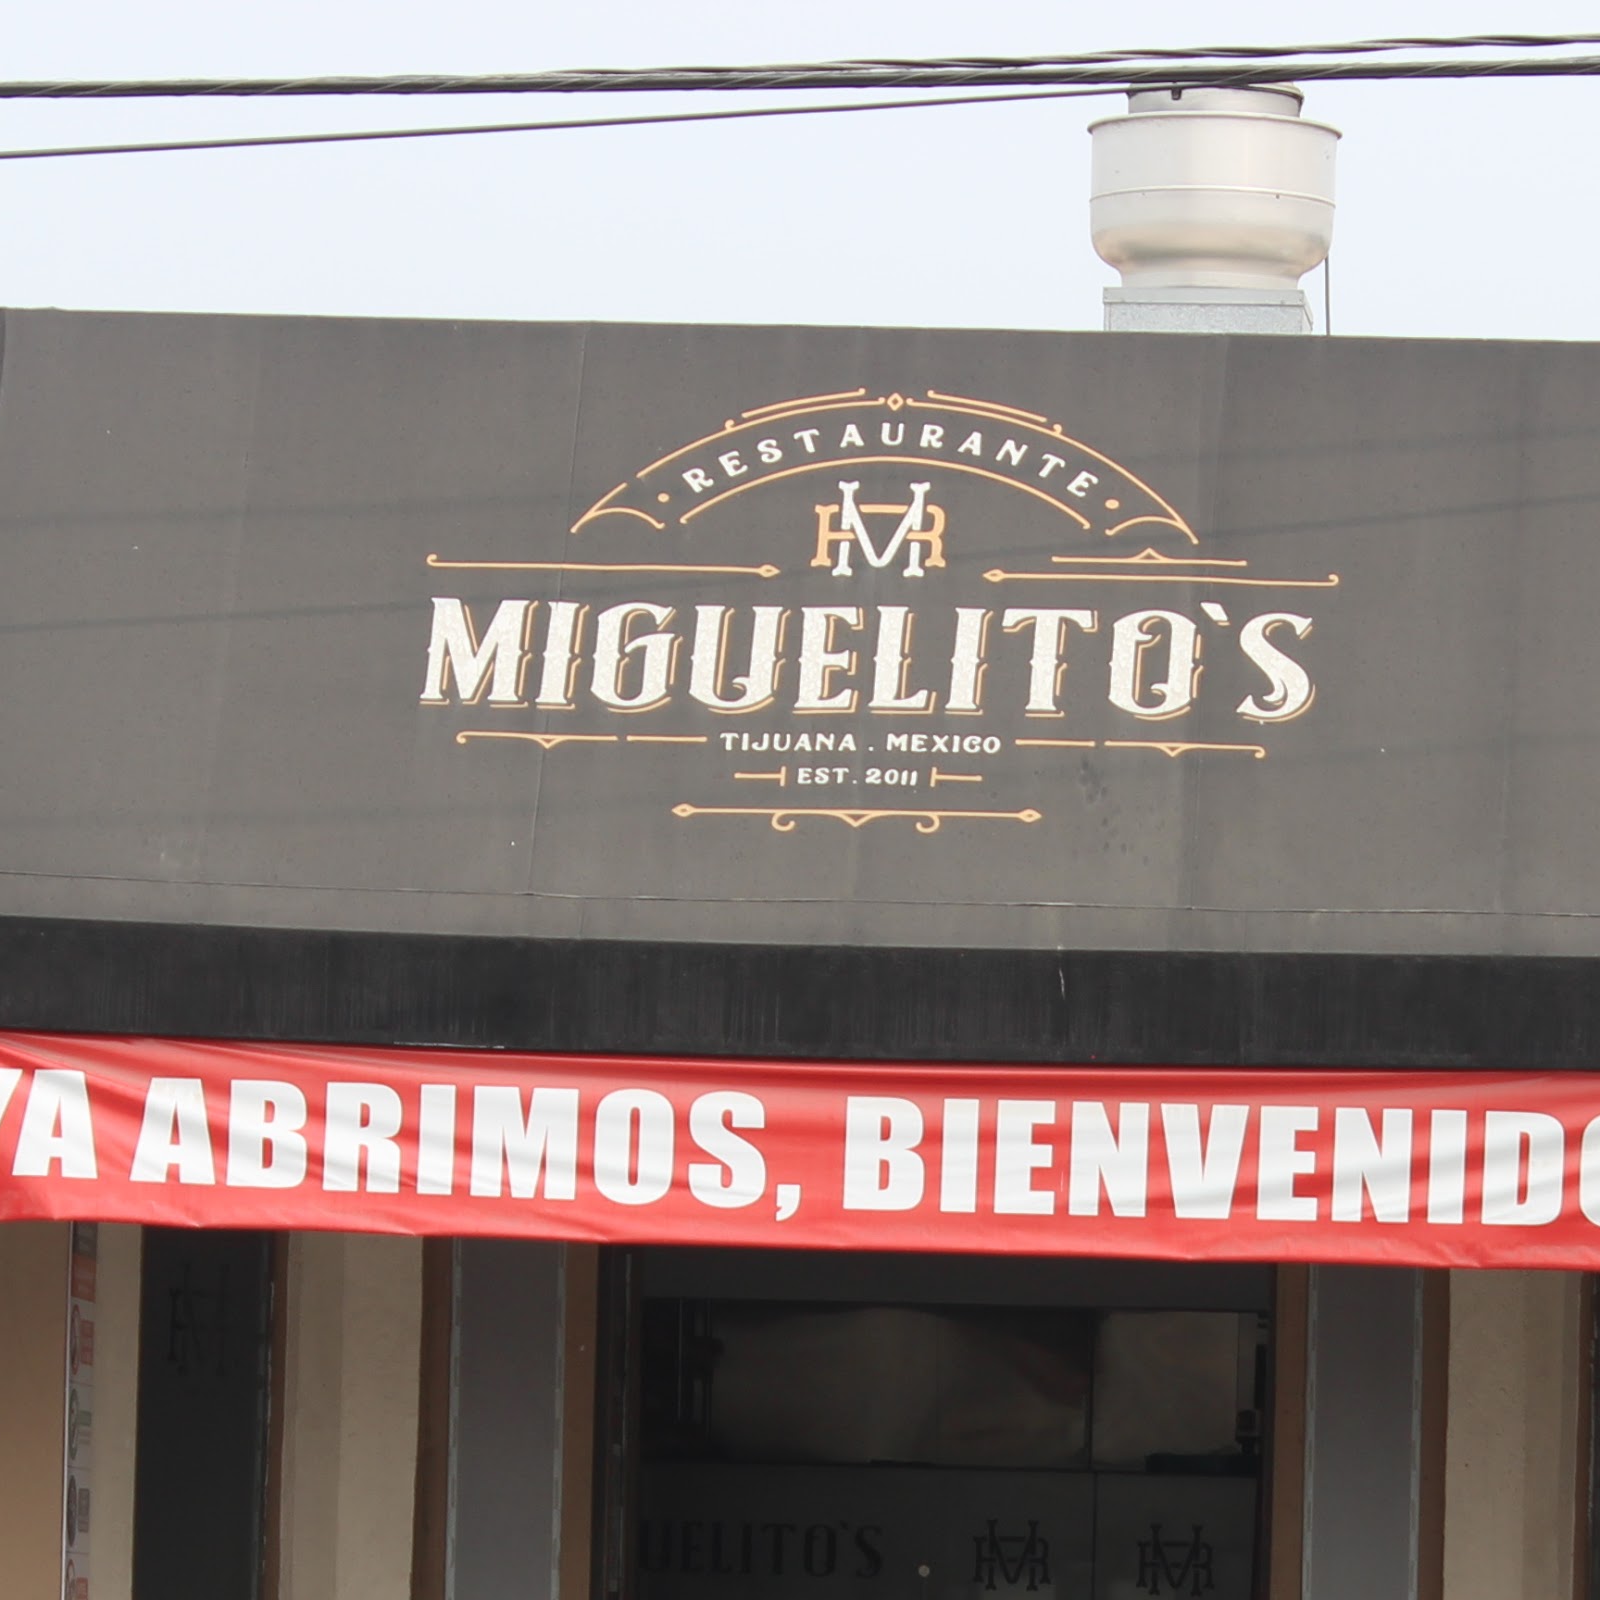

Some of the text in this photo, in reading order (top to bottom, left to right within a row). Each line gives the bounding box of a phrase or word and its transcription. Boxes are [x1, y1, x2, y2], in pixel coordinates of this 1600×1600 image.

[681, 421, 1100, 497] RESTAURANTE
[720, 732, 1002, 755] TIJUANA MEXICO
[797, 767, 919, 787] EST. 2011
[129, 1076, 802, 1222] ABRIMOS,
